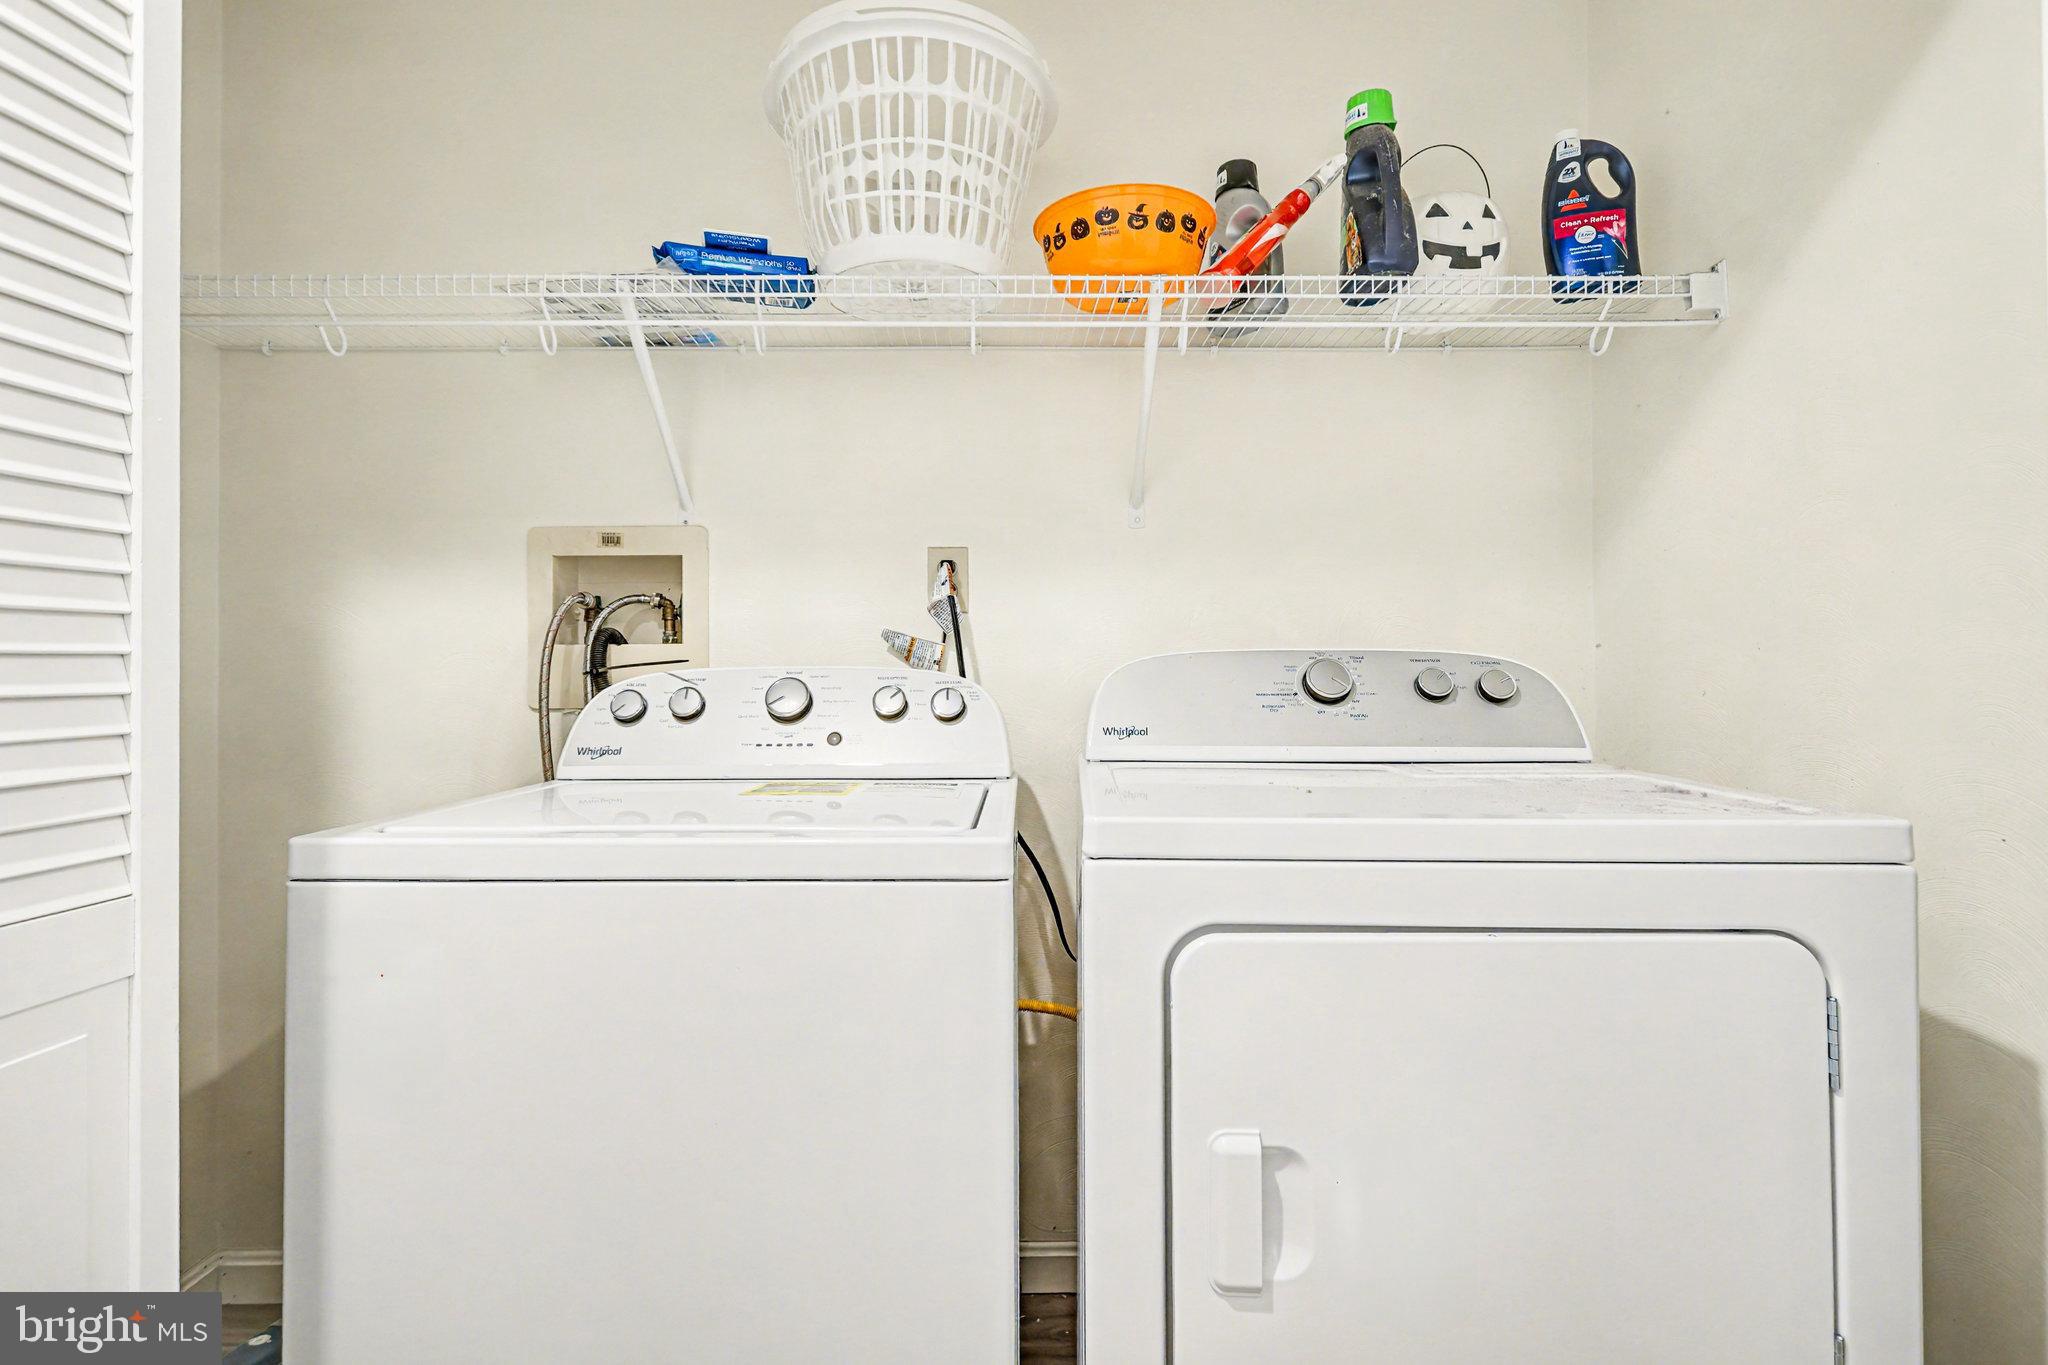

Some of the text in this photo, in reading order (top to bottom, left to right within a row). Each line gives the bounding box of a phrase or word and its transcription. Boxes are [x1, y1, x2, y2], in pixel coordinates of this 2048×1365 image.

[1562, 166, 1577, 176] 2X
[1560, 220, 1582, 228] Clean
[1590, 213, 1619, 223] Refresh
[701, 251, 737, 262] Premium
[738, 256, 783, 268] Washcloths
[1102, 726, 1149, 740] Whirlpool
[577, 746, 622, 760] Whirlpool
